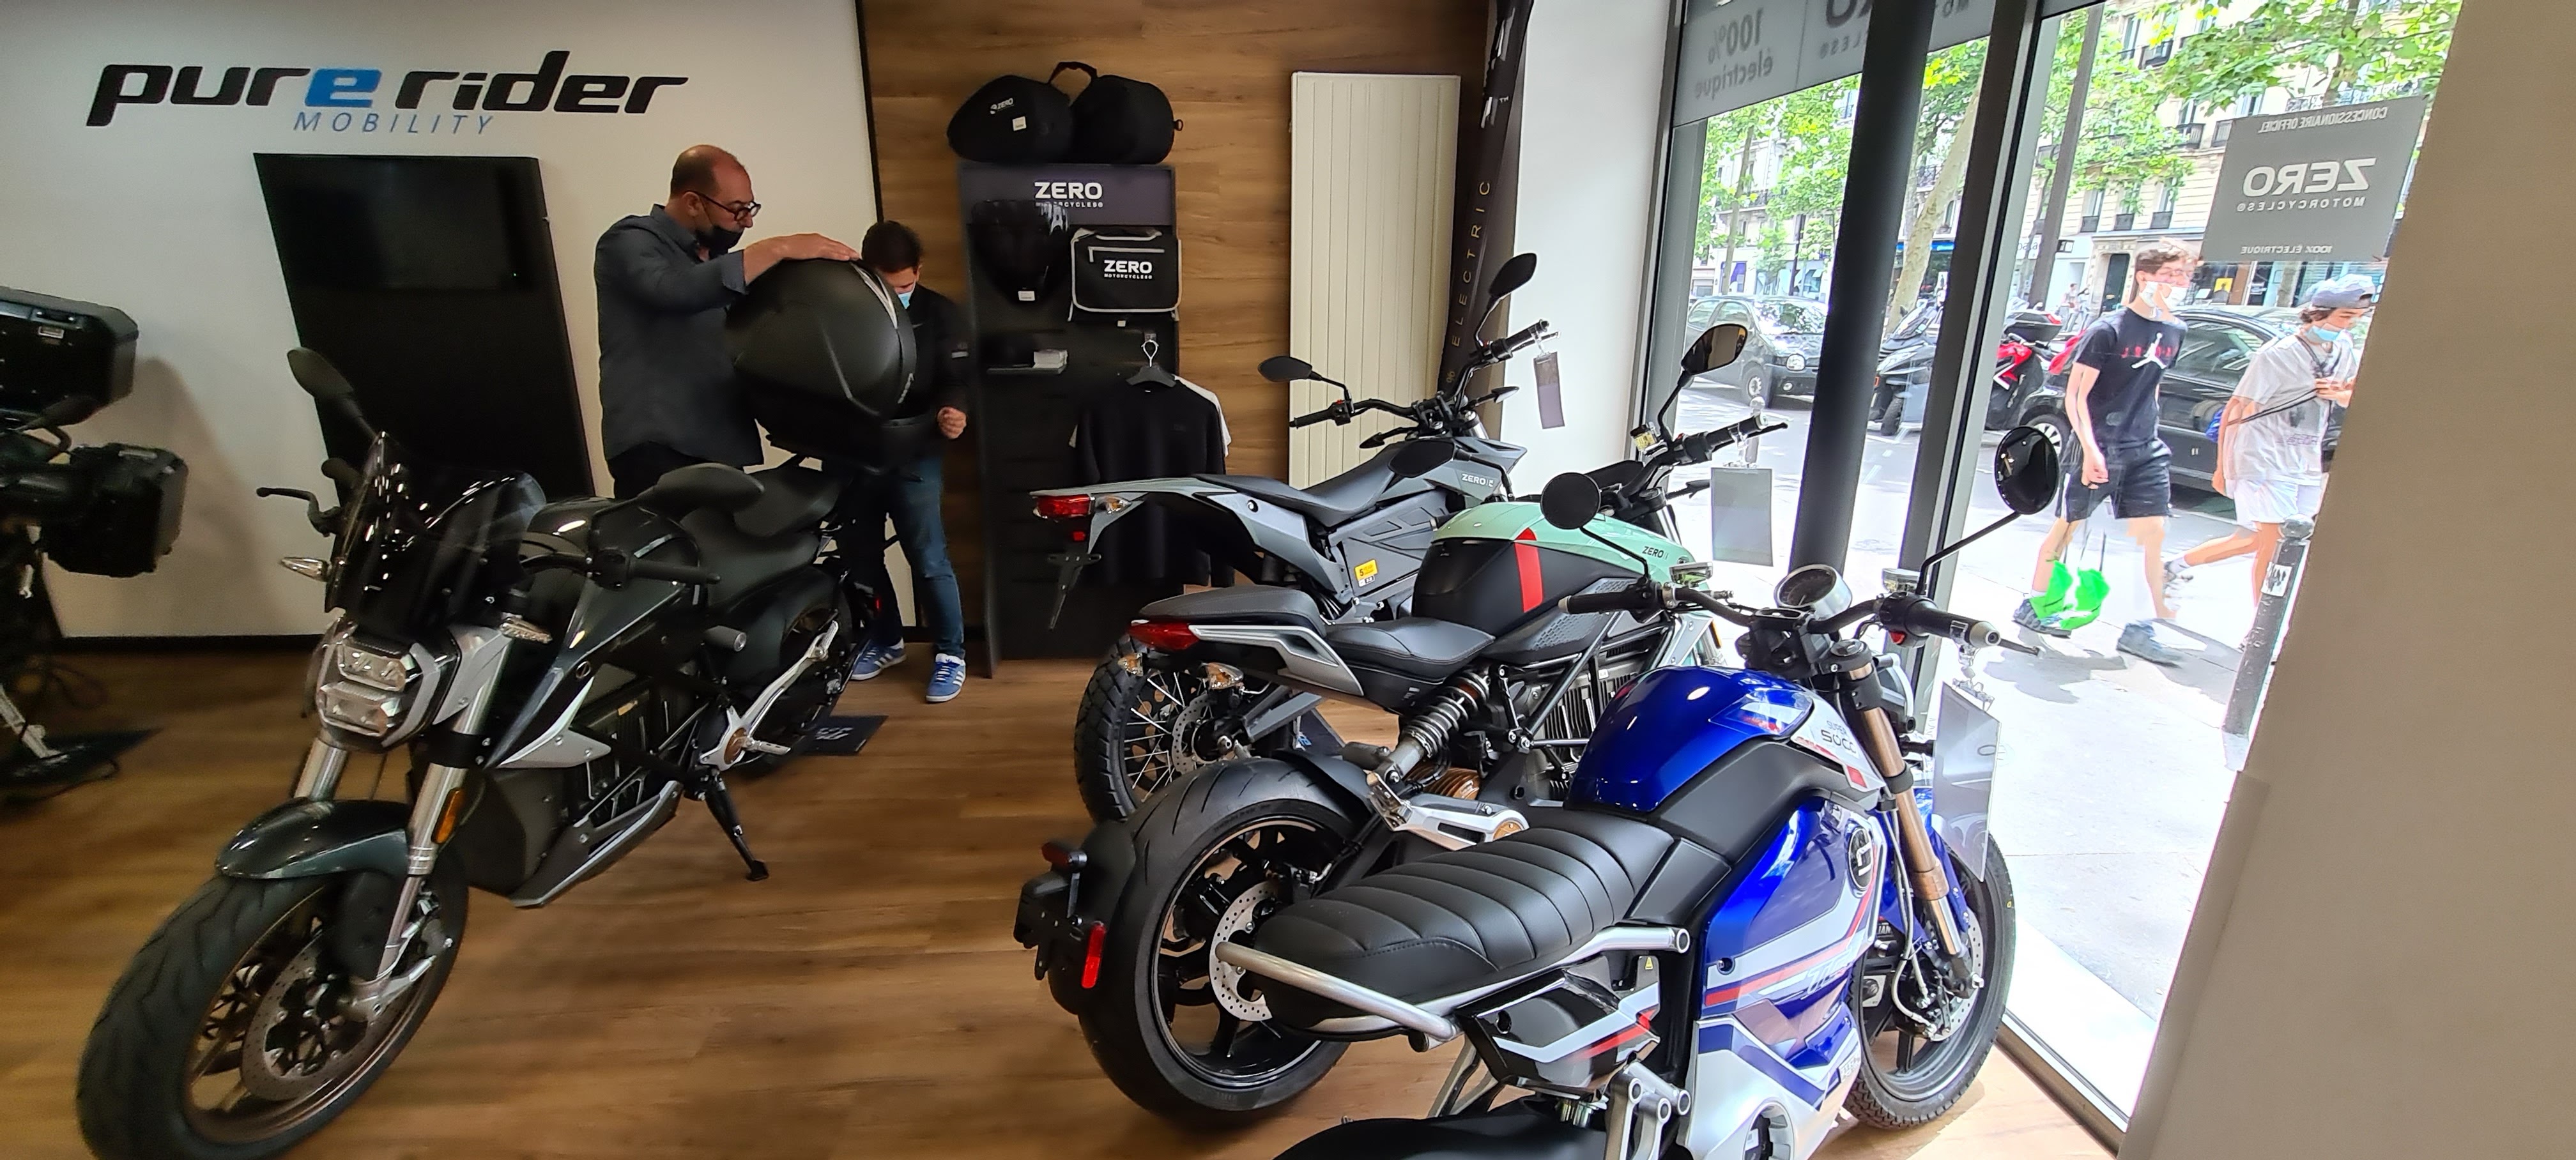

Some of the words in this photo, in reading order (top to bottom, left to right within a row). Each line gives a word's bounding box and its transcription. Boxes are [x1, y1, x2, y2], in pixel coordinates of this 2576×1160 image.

[86, 64, 382, 126] pure
[394, 50, 689, 114] rider
[293, 111, 494, 135] MOBILITY
[1034, 182, 1103, 200] ZERO
[1104, 259, 1153, 273] ZERO
[1452, 181, 1490, 347] ELECTRIC
[1462, 473, 1486, 485] ZERO
[1642, 546, 1664, 558] ZERO
